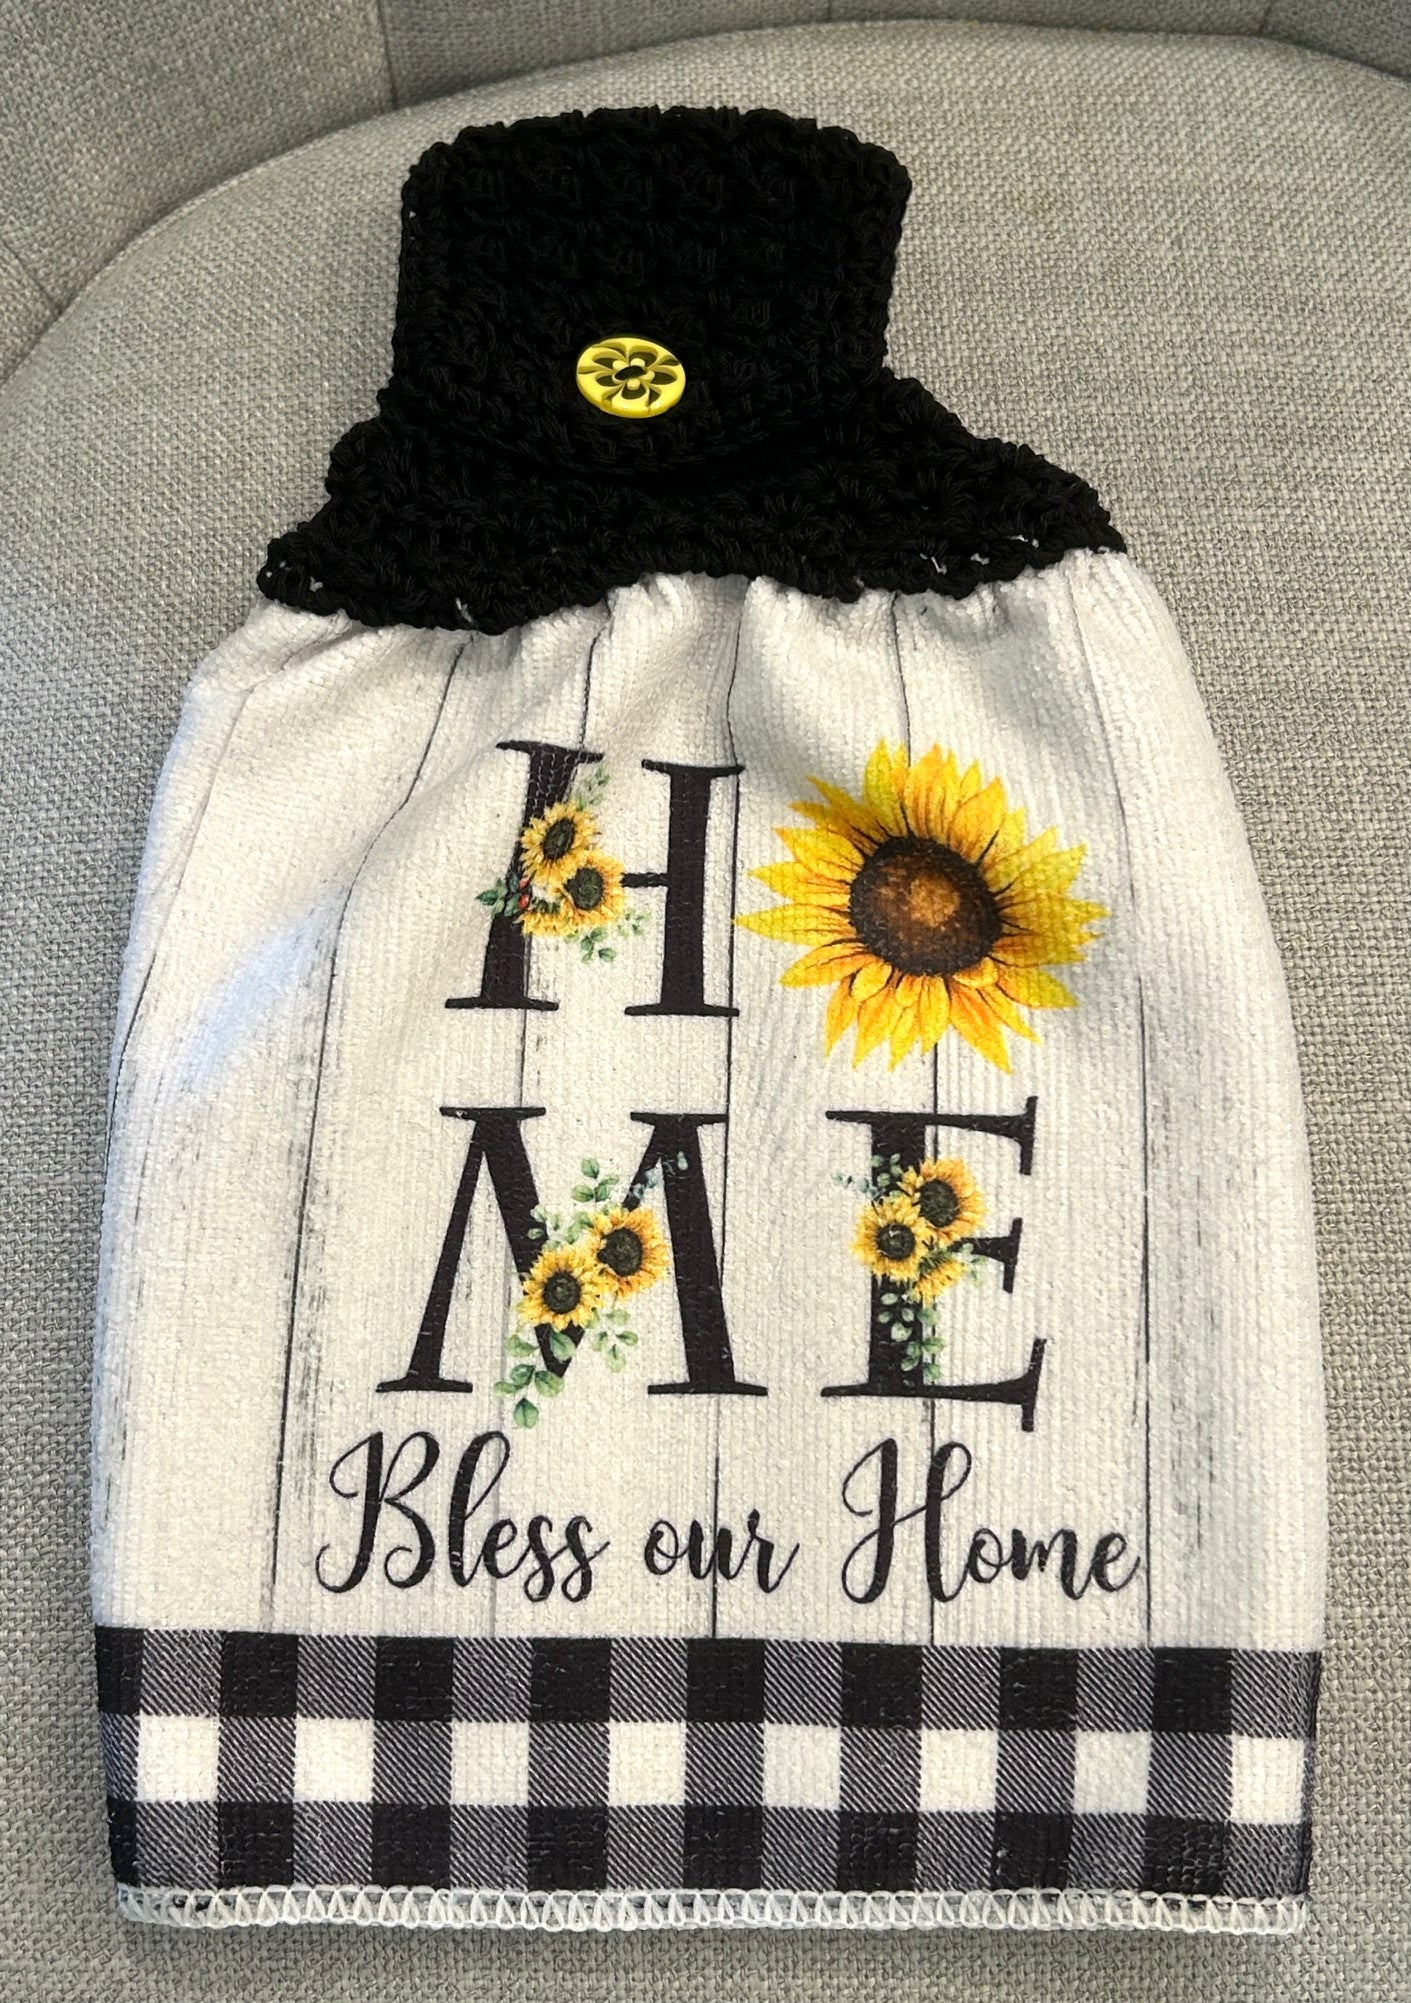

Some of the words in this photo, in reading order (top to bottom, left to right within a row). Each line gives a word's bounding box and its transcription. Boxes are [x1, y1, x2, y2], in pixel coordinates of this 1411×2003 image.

[315, 1430, 610, 1603] Bless
[643, 1508, 800, 1593] our
[840, 1438, 1141, 1605] Home
